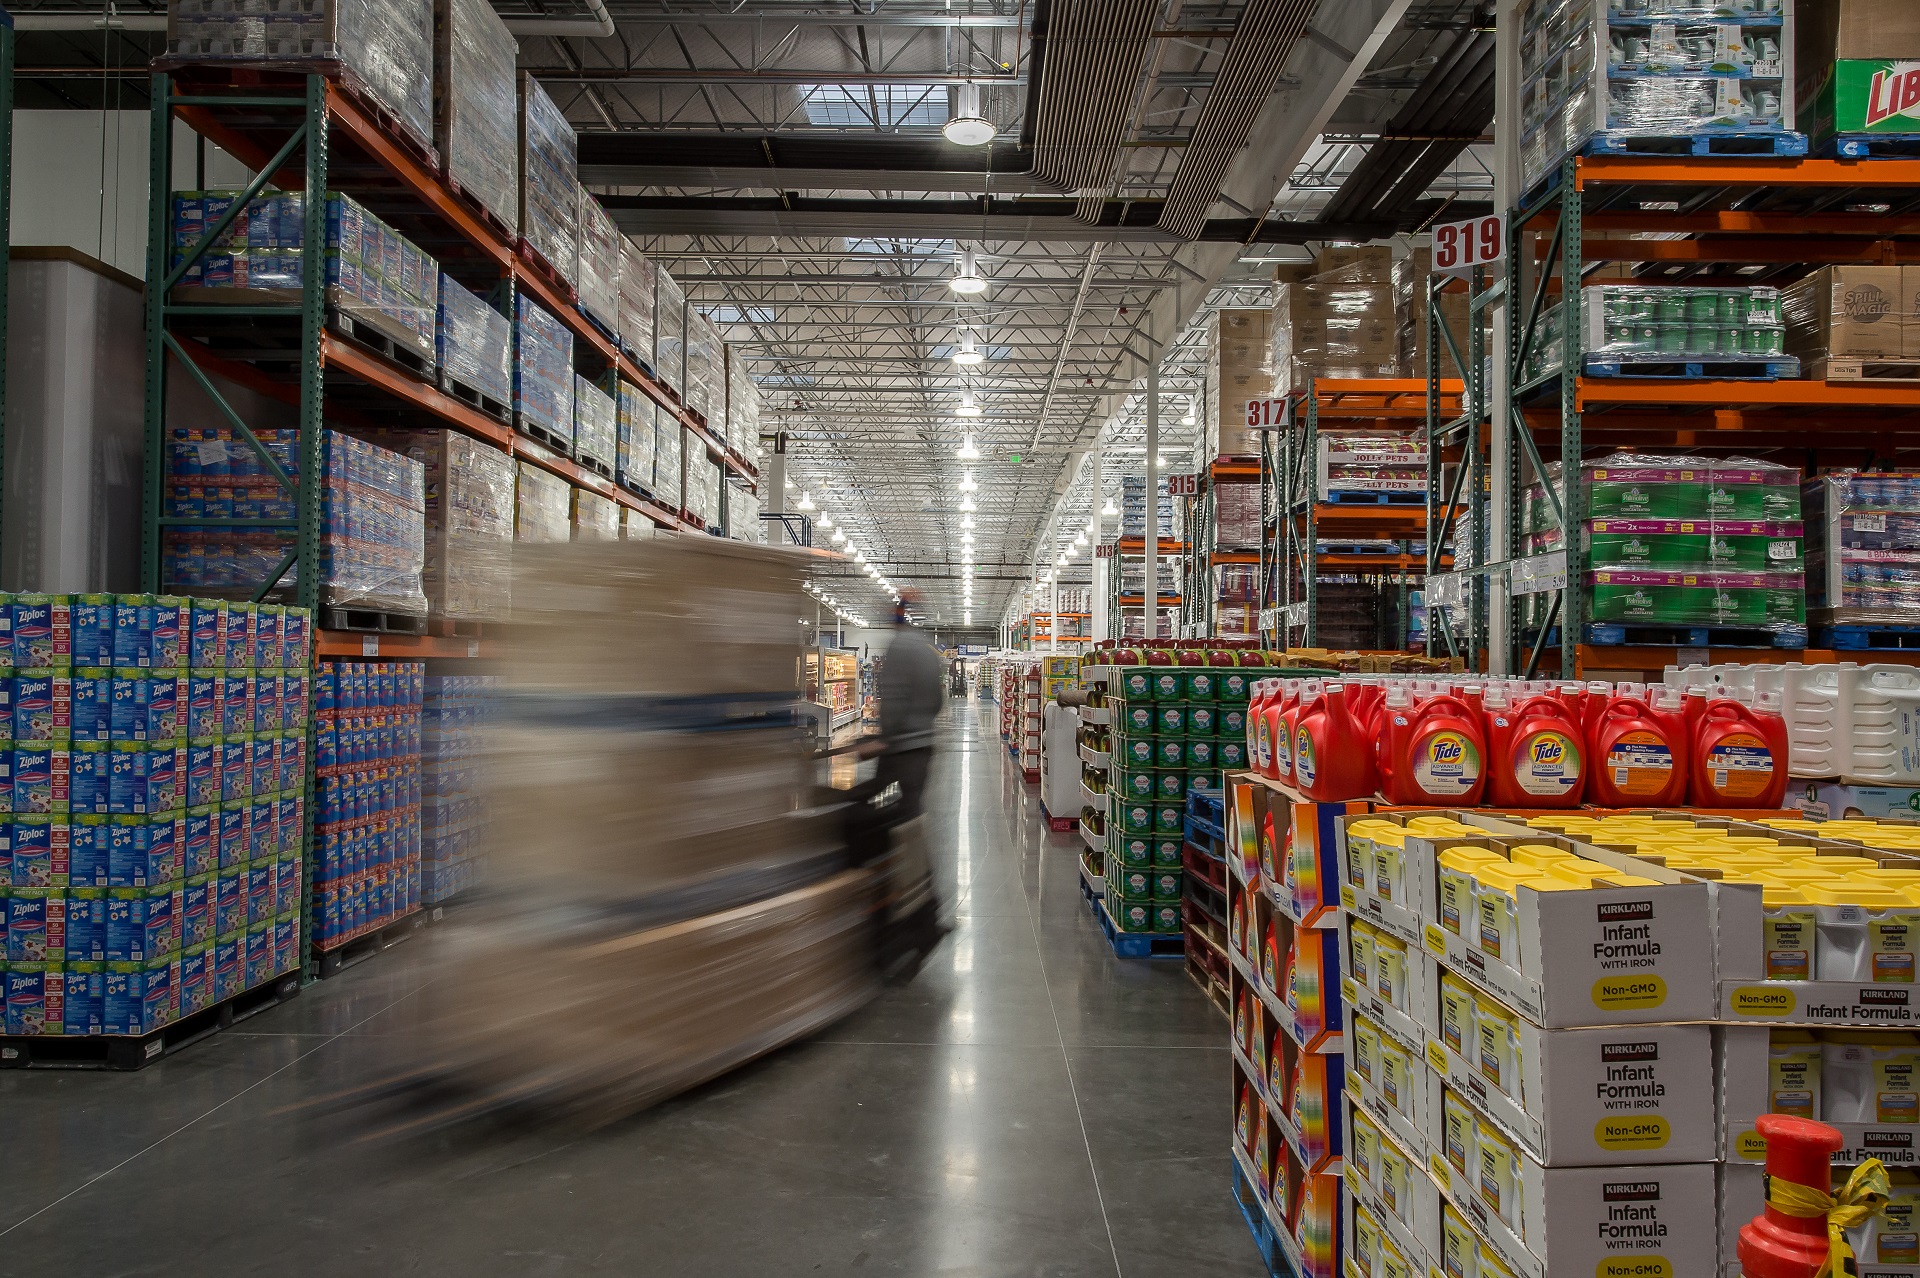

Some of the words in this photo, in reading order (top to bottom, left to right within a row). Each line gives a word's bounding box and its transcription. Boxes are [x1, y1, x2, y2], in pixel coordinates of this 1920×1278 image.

[1437, 217, 1501, 268] 319
[1844, 291, 1883, 304] SPILL
[1842, 302, 1891, 318] MAGIC
[1248, 400, 1286, 426] 317
[1354, 454, 1383, 462] JOLLY
[1169, 475, 1195, 494] 315
[1622, 493, 1649, 503] Palmolive
[1096, 545, 1113, 557] 313
[1622, 545, 1649, 555] Palmolive
[1552, 574, 1566, 587] 5.99
[1717, 577, 1726, 585] 2x
[1625, 596, 1652, 607] Palmolive
[18, 609, 46, 623] Ziploc
[77, 607, 95, 616] Ziploc
[117, 607, 136, 617] Ziploc
[21, 682, 47, 696] Ziploc
[75, 681, 93, 690] Ziploc
[114, 681, 131, 690] Ziploc
[1433, 742, 1462, 762] Tide
[1534, 742, 1562, 762] Tide
[19, 755, 45, 768] Ziploc
[74, 754, 92, 763] Ziploc
[112, 754, 131, 763] Ziploc
[18, 828, 45, 842] Ziploc
[73, 827, 92, 837] Ziploc
[112, 827, 131, 837] Ziploc
[13, 902, 41, 916] Ziploc
[69, 901, 88, 911] Ziploc
[109, 901, 128, 911] Ziploc
[1600, 903, 1651, 914] KIRKLAND
[1603, 924, 1650, 941] Infant
[1594, 940, 1661, 958] Formula
[1449, 951, 1464, 970] Infant
[1464, 960, 1487, 984] Formula
[1601, 960, 1628, 969] WITH
[1630, 958, 1655, 968] IRON
[11, 976, 39, 990] Ziploc
[67, 975, 86, 984] Ziploc
[106, 975, 126, 984] Ziploc
[284, 980, 297, 992] iGPS
[1603, 983, 1656, 996] Non-GMO
[1739, 995, 1787, 1004] Non-GMO
[1806, 1004, 1848, 1018] Infant
[1851, 1005, 1910, 1020] Formula
[1604, 1044, 1656, 1054] KIRKLAND
[1606, 1065, 1655, 1081] Infant
[1451, 1072, 1466, 1094] Infant
[1466, 1085, 1488, 1113] Formula
[1597, 1081, 1665, 1098] Formula
[1604, 1101, 1631, 1110] WITH
[1634, 1100, 1660, 1108] IRON
[1605, 1124, 1660, 1136] Non-GMO
[1744, 1139, 1767, 1148] Non-
[1830, 1150, 1851, 1161] ant
[1855, 1149, 1915, 1162] Formula
[1606, 1184, 1658, 1194] KIRKLAND
[1608, 1204, 1657, 1221] Infant
[1468, 1205, 1490, 1240] Formula
[1598, 1220, 1668, 1238] Formula
[1605, 1240, 1633, 1249] WITH
[1636, 1240, 1662, 1248] IRON
[1607, 1264, 1662, 1276] Non-GMO
